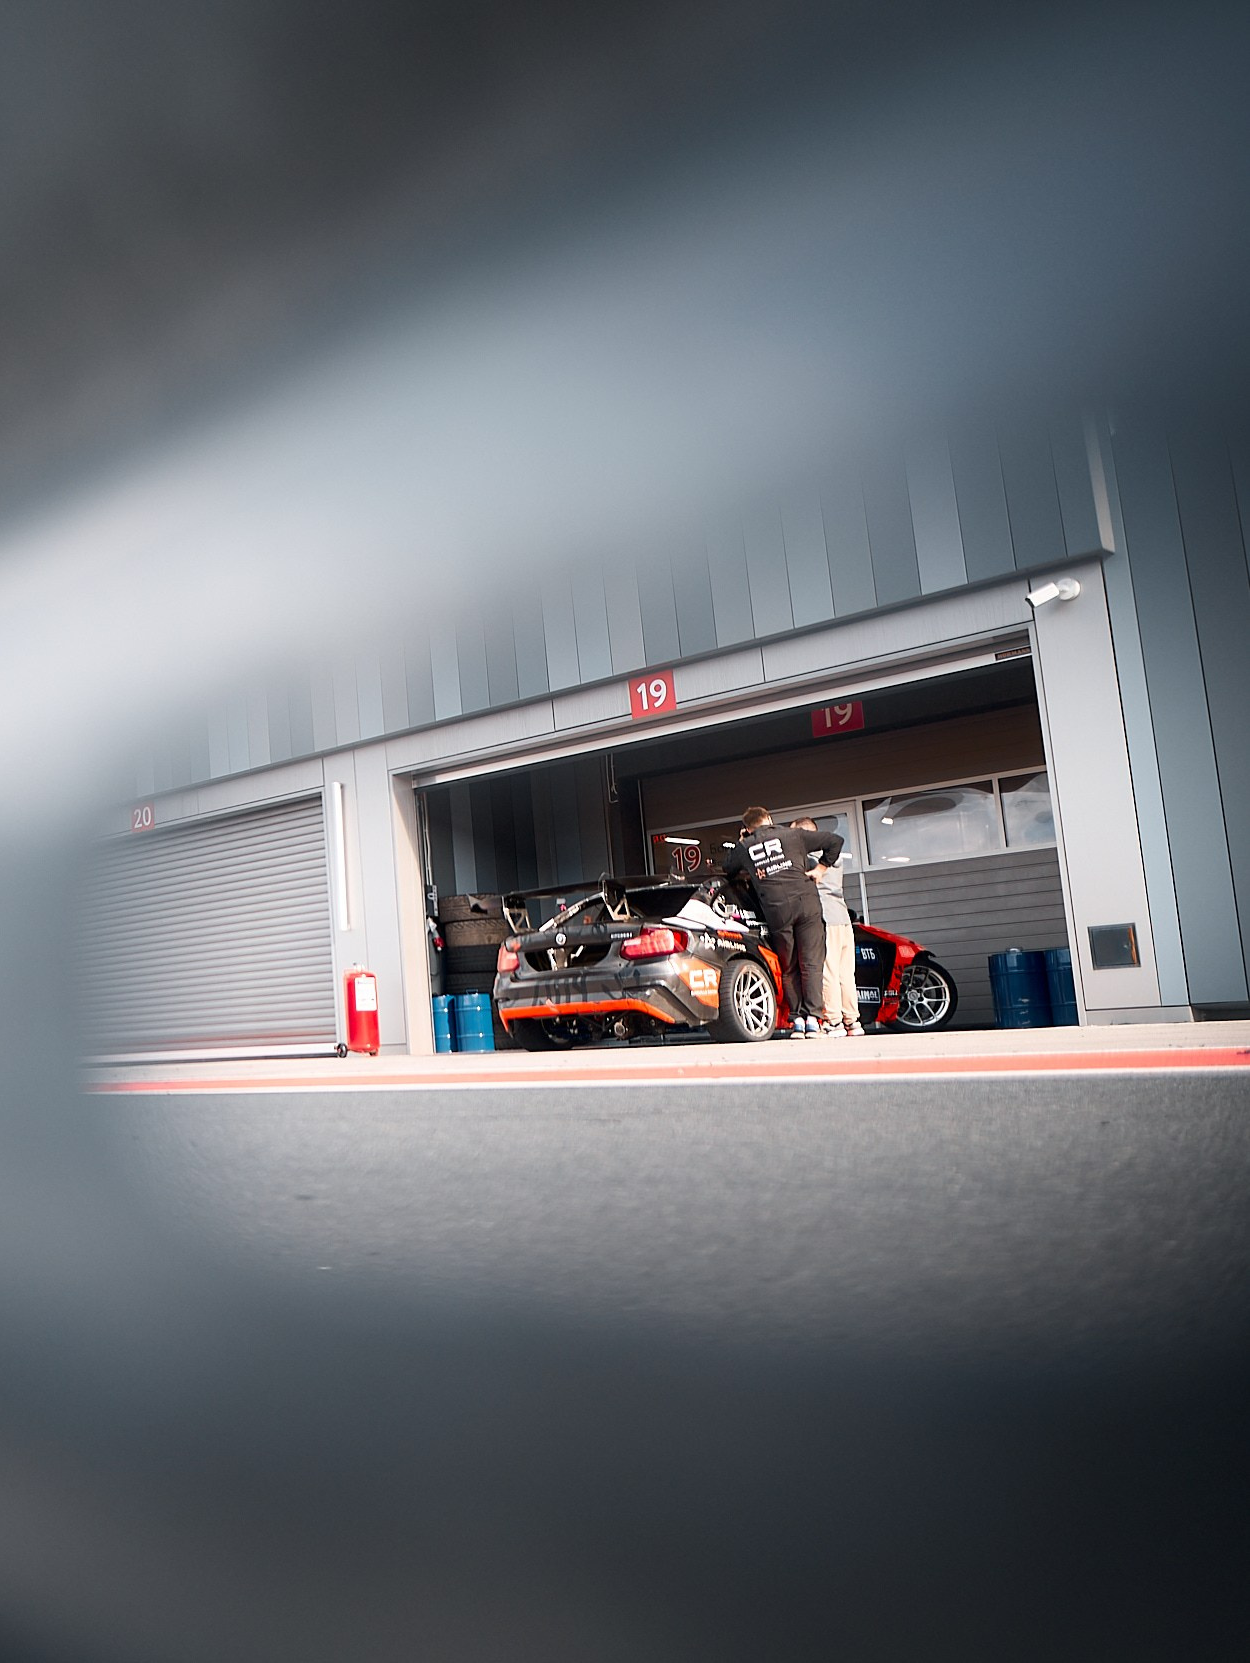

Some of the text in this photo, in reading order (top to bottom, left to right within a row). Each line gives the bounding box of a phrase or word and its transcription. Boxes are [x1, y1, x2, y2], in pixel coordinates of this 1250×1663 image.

[636, 678, 668, 711] 19
[821, 702, 853, 729] 19
[133, 806, 152, 829] 20
[671, 845, 702, 873] 19
[748, 838, 784, 861] CR
[860, 947, 876, 960] ВТБ
[689, 968, 718, 988] CR
